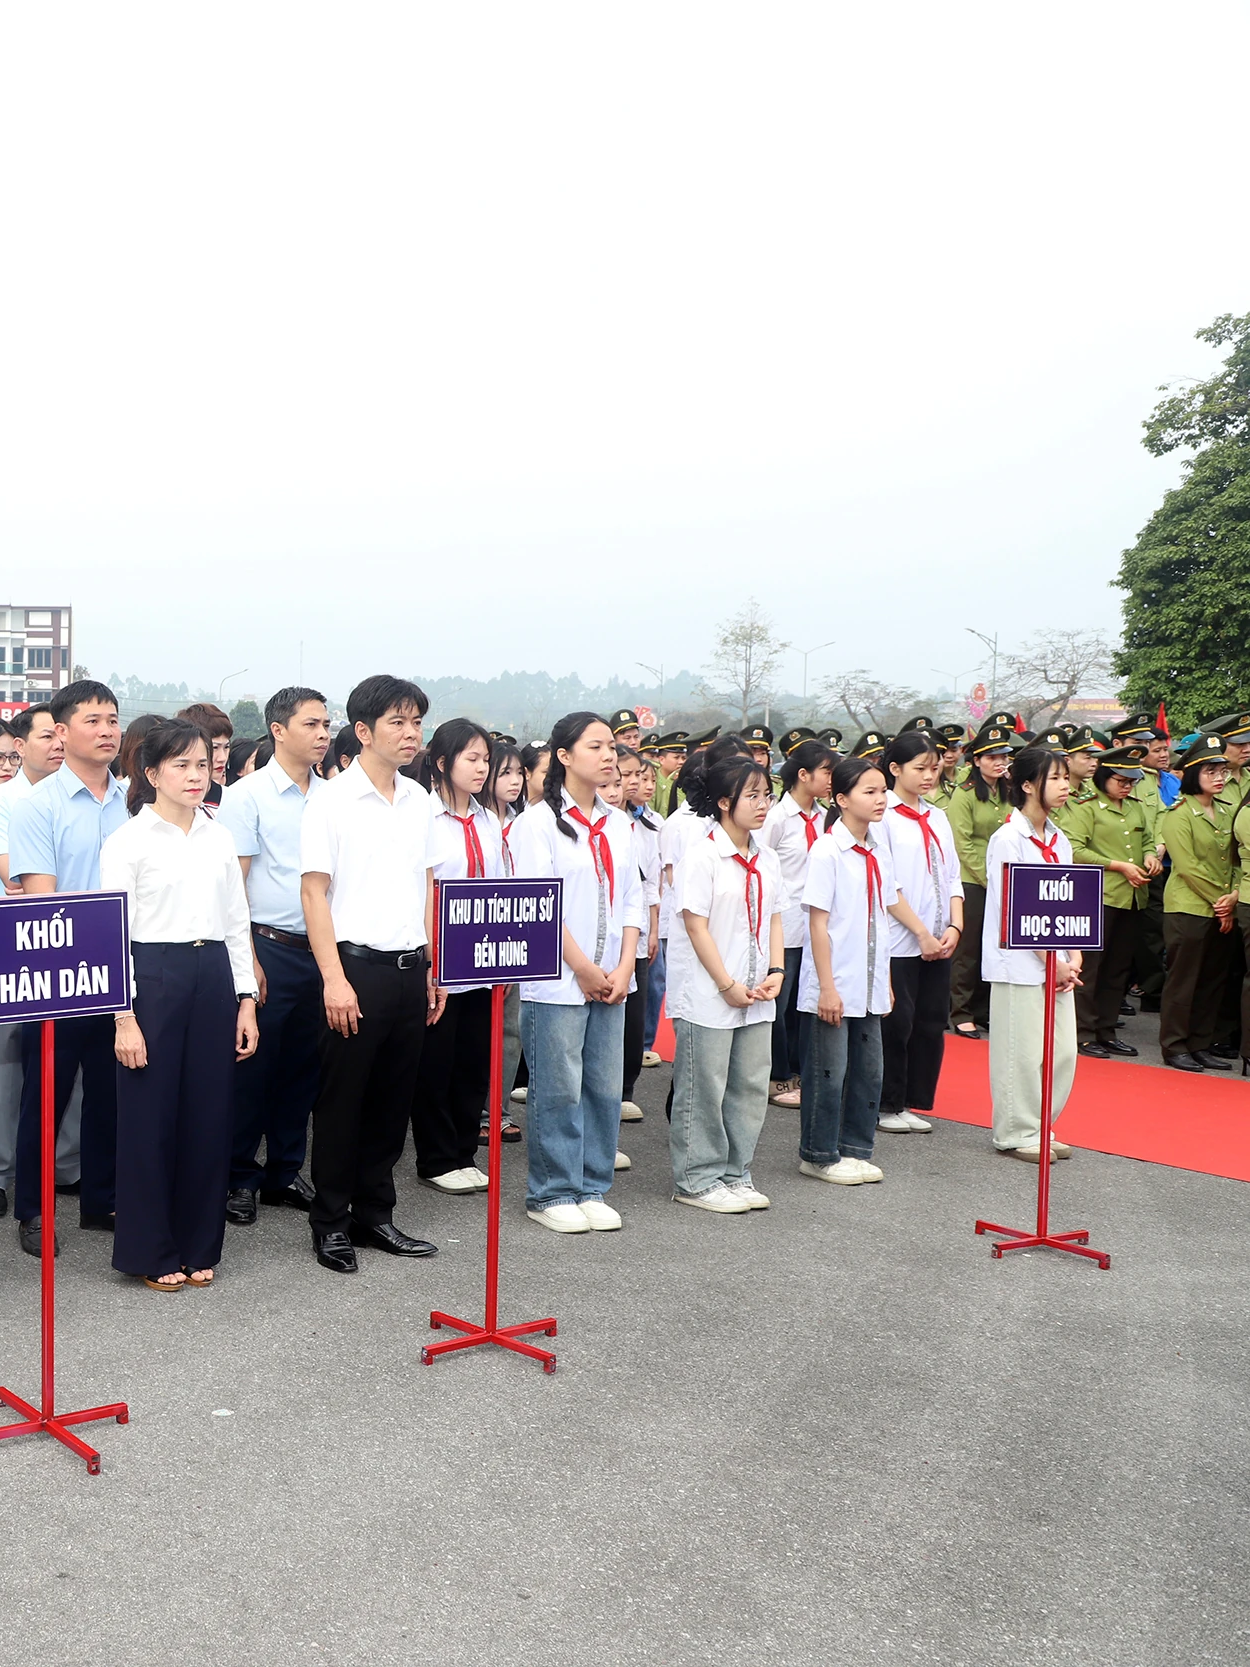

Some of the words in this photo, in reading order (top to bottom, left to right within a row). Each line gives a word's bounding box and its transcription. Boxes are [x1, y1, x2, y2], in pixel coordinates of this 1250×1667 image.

[1038, 872, 1074, 902] KHỐI
[448, 898, 472, 925] KHU
[473, 898, 485, 924] DI
[487, 892, 512, 924] TÍCH
[513, 897, 537, 928] LỊCH
[538, 888, 555, 922] SỬ
[15, 907, 74, 951] KHỐI
[1020, 915, 1051, 941] HỌC
[1054, 915, 1091, 937] SINH
[474, 933, 497, 968] ĐỀN
[498, 935, 528, 967] HÙNG
[58, 960, 110, 999] DÂN
